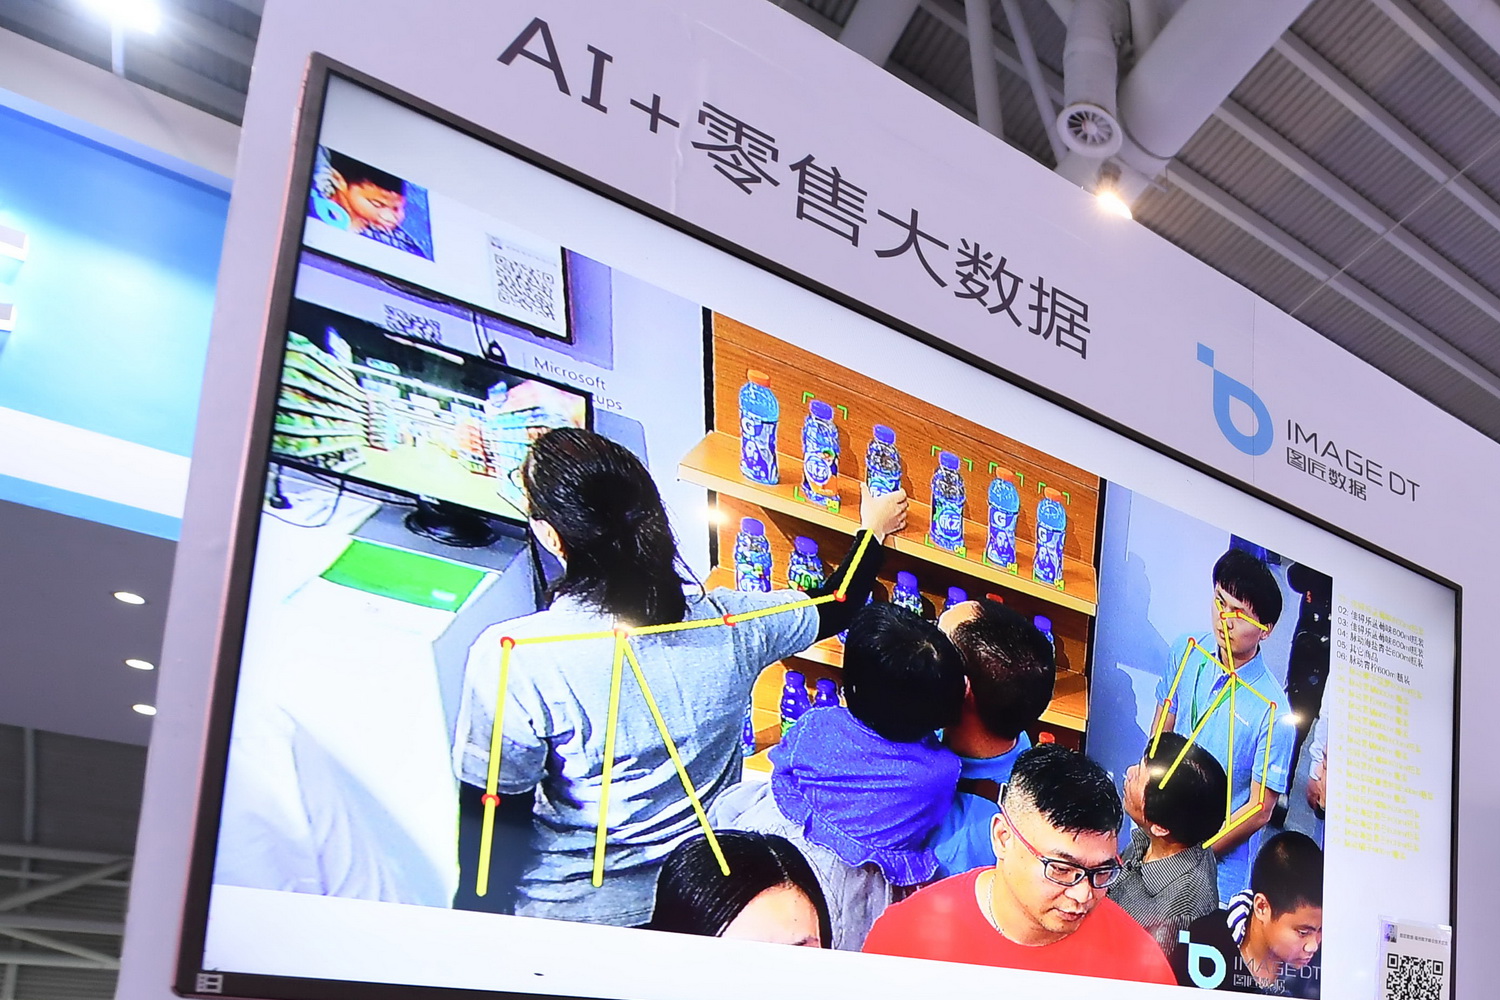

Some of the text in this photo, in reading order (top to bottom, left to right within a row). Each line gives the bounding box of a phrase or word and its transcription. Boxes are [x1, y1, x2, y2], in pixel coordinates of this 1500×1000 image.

[497, 17, 1091, 360] AI+零售大数据
[534, 356, 607, 392] Microsoft
[1286, 446, 1366, 501] 图匠数据
[1287, 419, 1420, 502] IMAGE DT
